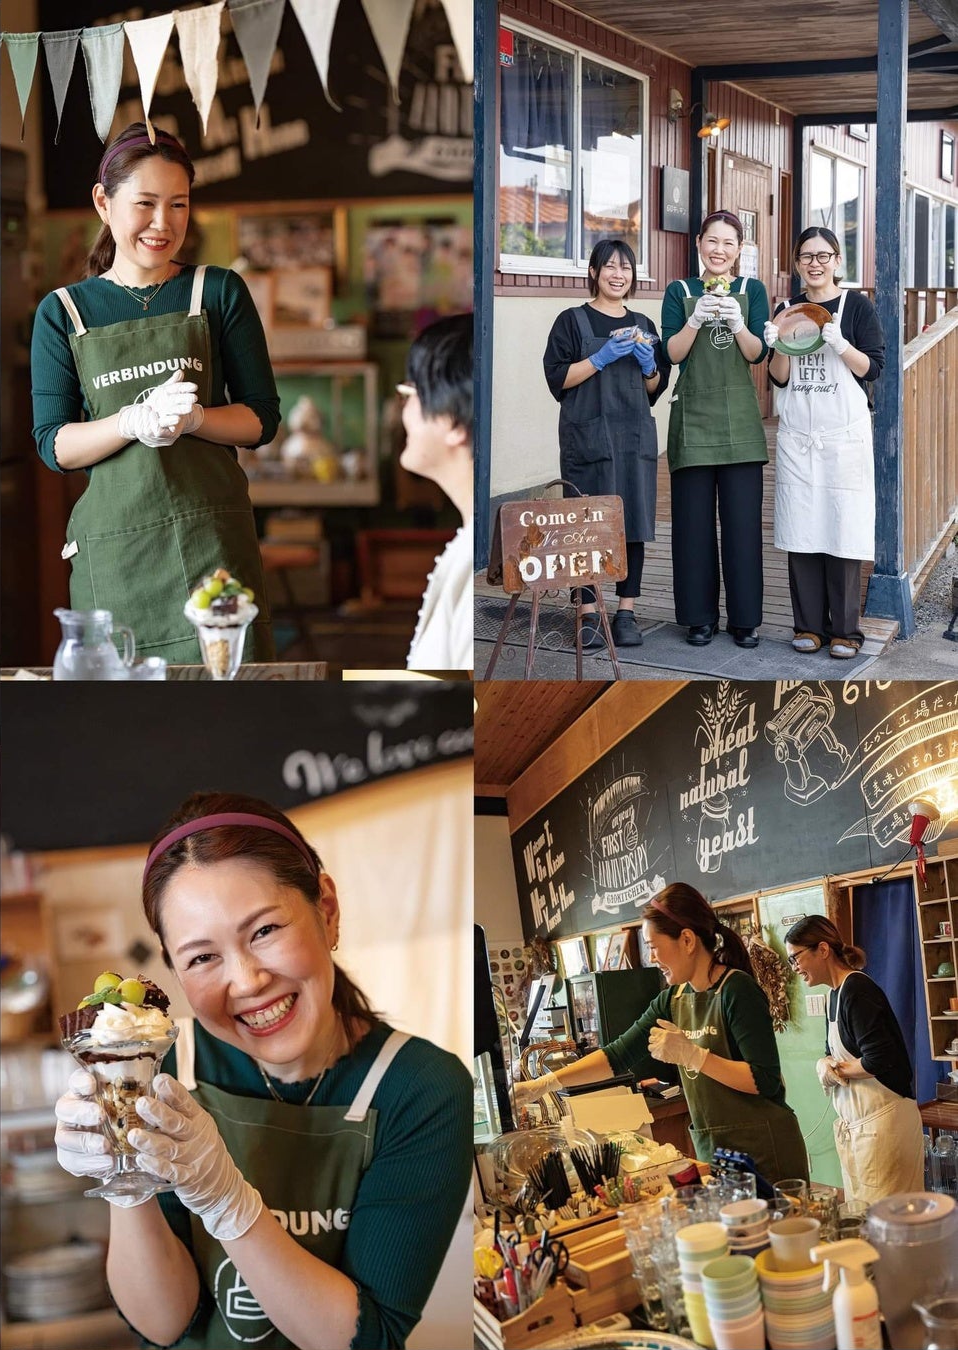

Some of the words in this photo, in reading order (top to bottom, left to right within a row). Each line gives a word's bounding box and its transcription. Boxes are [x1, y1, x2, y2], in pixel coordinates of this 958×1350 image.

[92, 357, 203, 390] VERBINDUNG
[798, 353, 825, 366] HEY!
[799, 367, 826, 381] LET'S
[519, 511, 577, 527] Come
[582, 507, 604, 523] In
[563, 528, 598, 545] Are
[519, 549, 613, 582] OPEN
[700, 702, 759, 766] wheat
[679, 748, 751, 811] natural
[602, 830, 624, 858] FIRST
[699, 806, 759, 873] yeast
